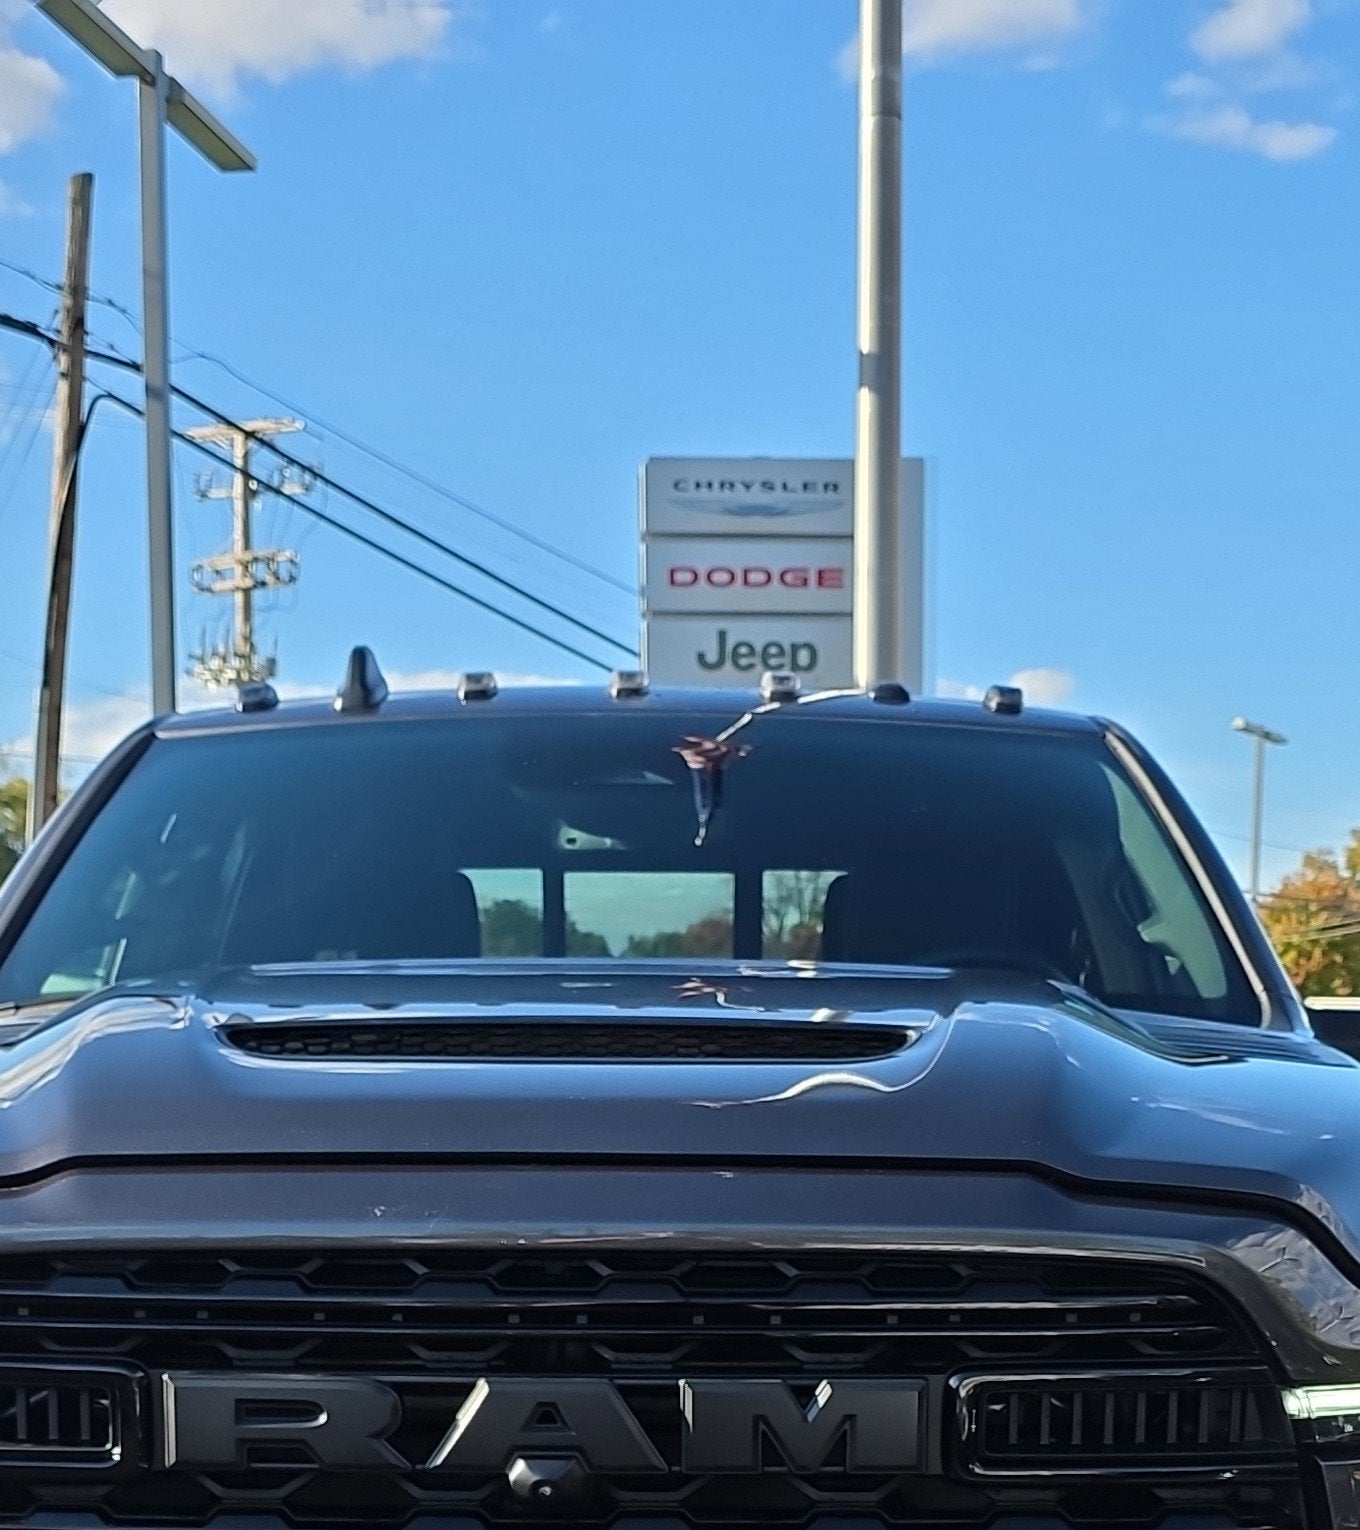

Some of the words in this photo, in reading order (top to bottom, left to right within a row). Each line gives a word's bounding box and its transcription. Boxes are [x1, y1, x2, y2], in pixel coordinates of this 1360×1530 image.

[671, 479, 840, 495] CHRYSLER
[669, 566, 844, 589] DODGE
[696, 629, 818, 672] Jeep
[163, 1372, 929, 1473] RAM
